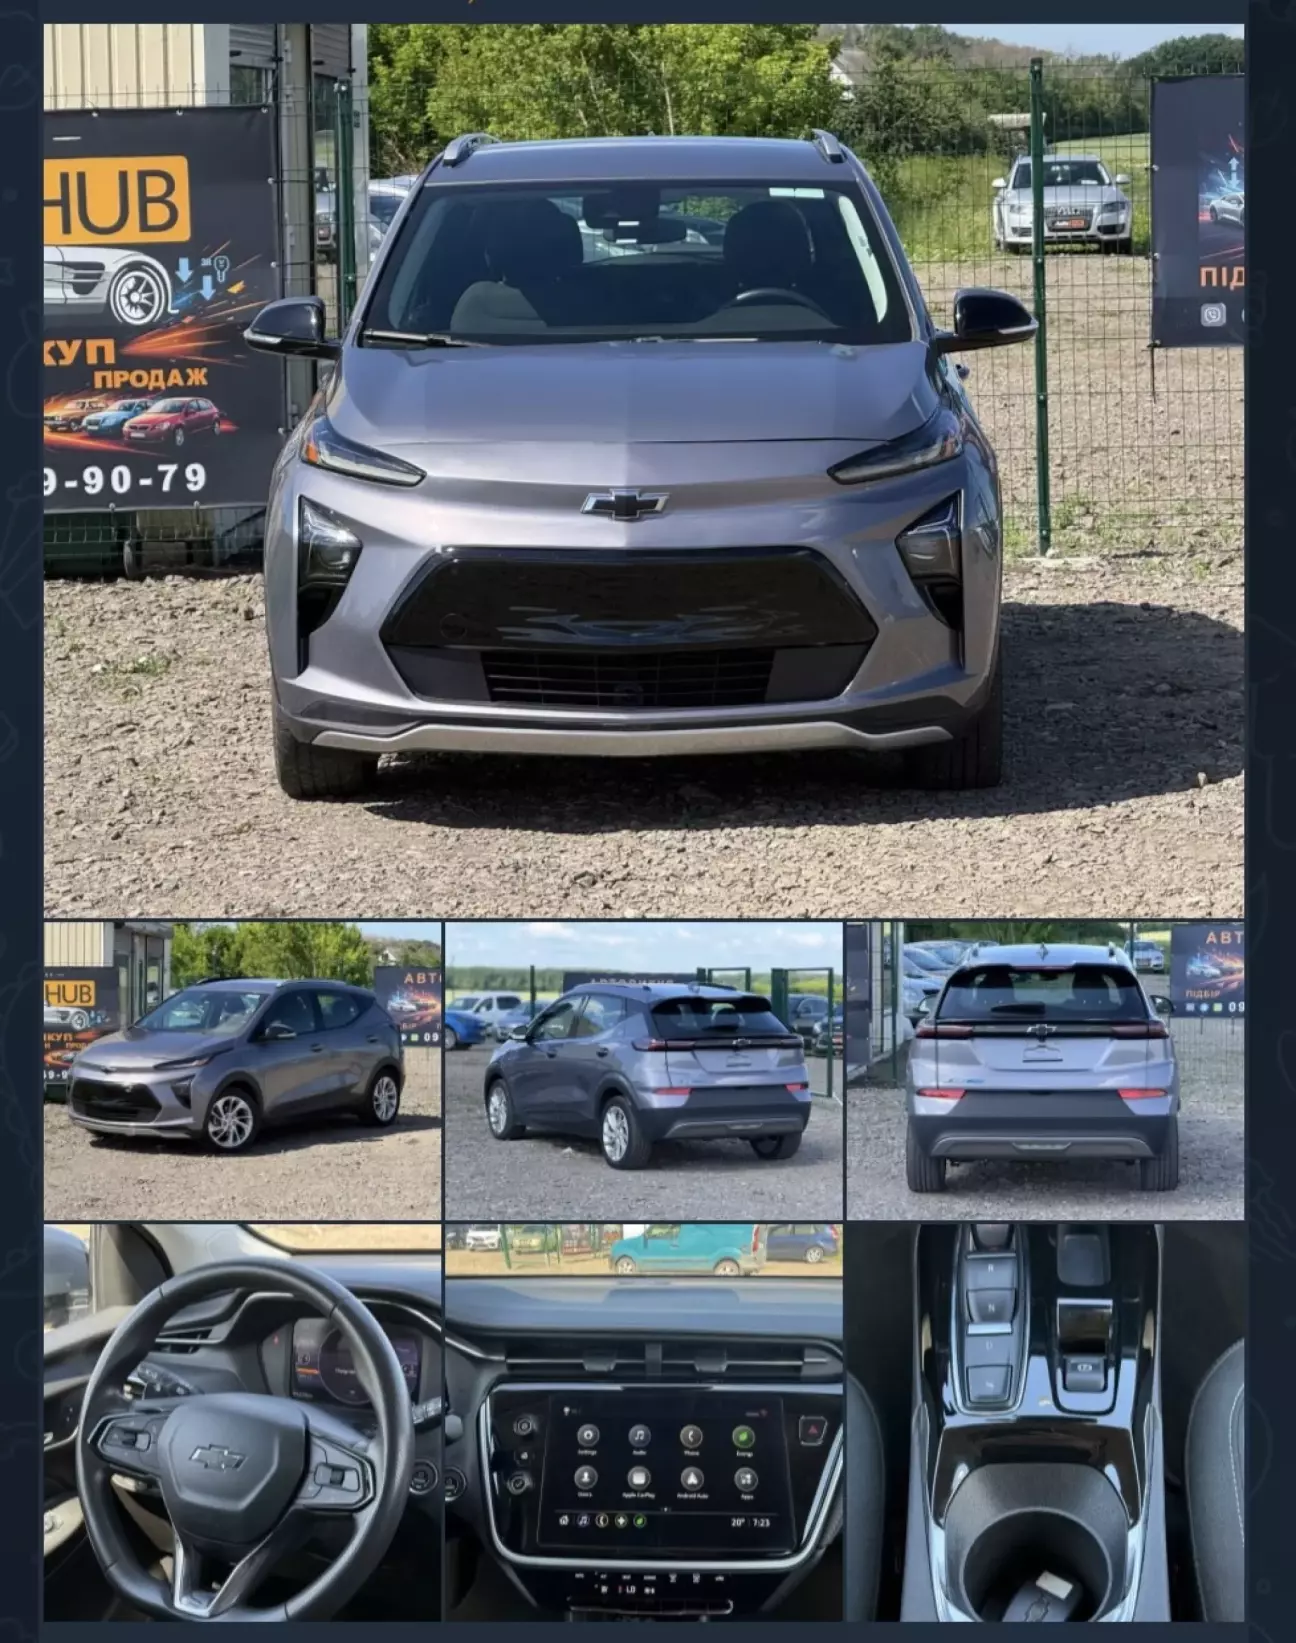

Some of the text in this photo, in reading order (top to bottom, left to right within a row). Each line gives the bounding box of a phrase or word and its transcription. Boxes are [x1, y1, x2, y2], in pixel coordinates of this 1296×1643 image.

[44, 169, 179, 235] HUB
[94, 368, 208, 390] ПРОДАЖ
[45, 984, 92, 1003] HUB
